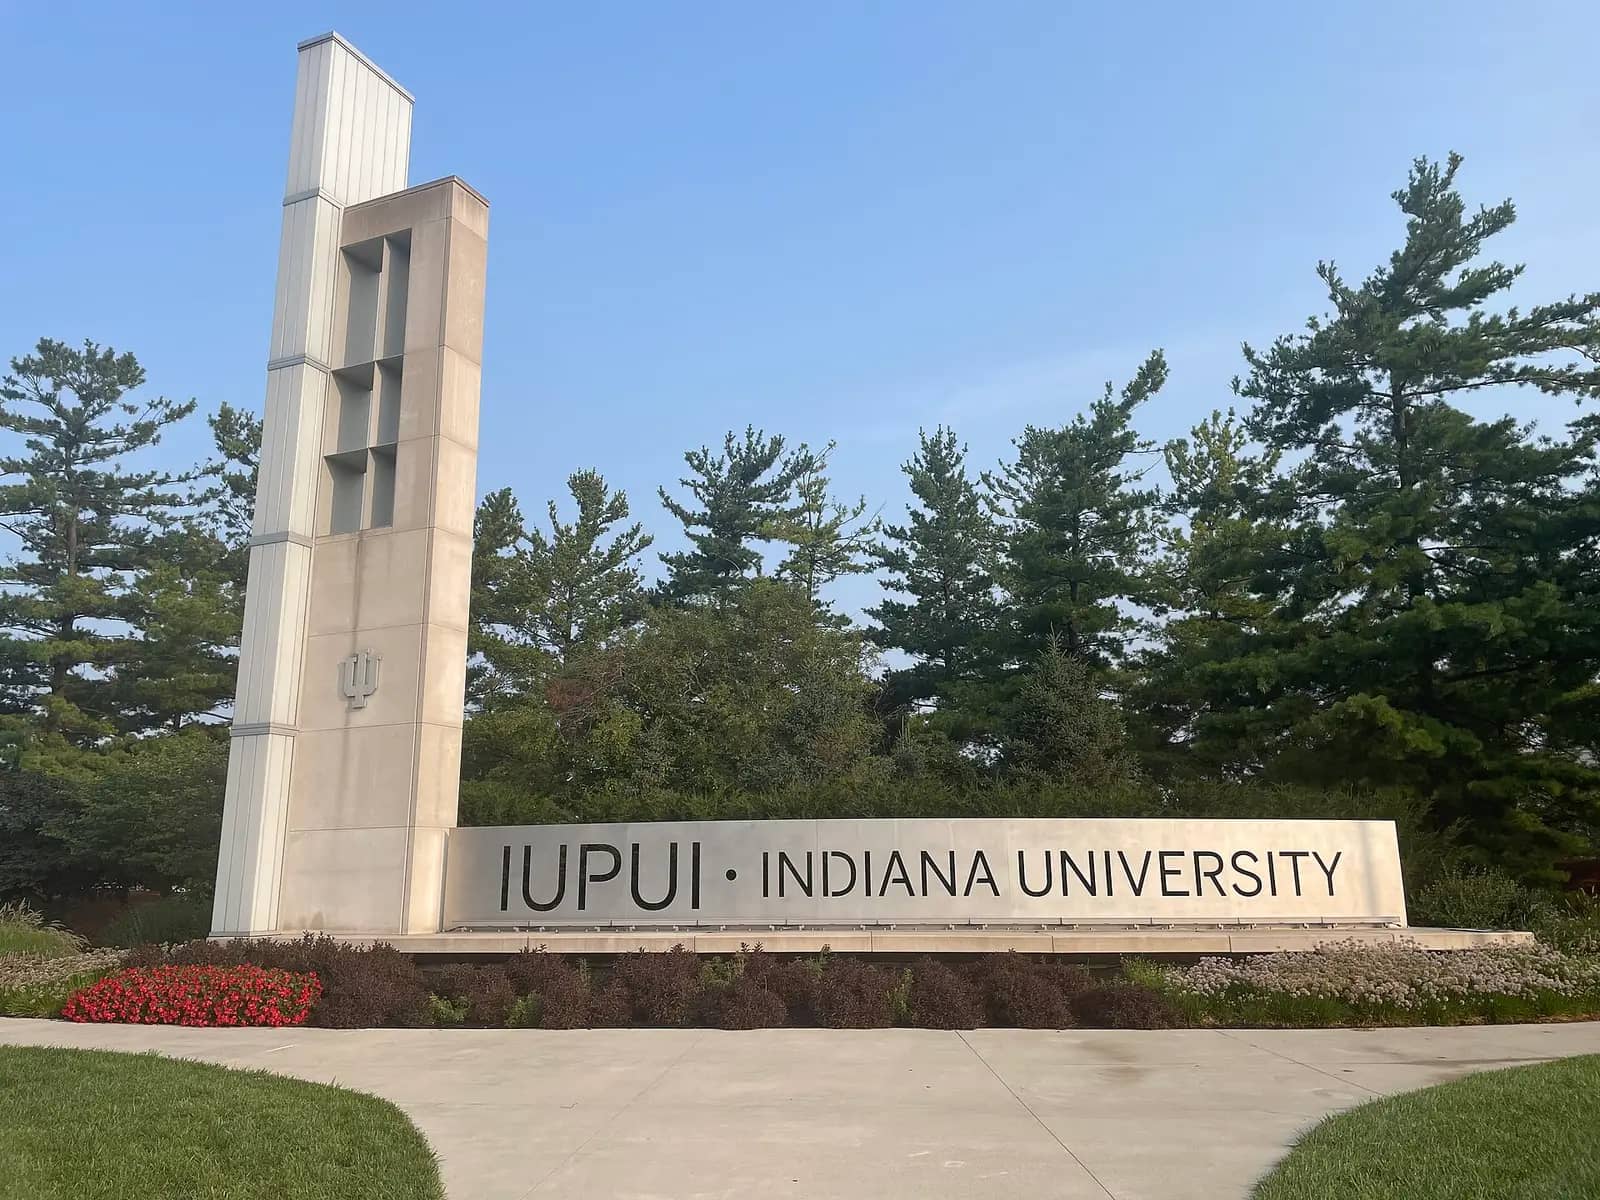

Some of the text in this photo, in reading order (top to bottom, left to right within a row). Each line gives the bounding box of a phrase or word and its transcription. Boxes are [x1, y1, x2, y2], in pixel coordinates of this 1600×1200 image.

[500, 841, 1342, 912] IUPUI INDIANA UNIVERSITY
